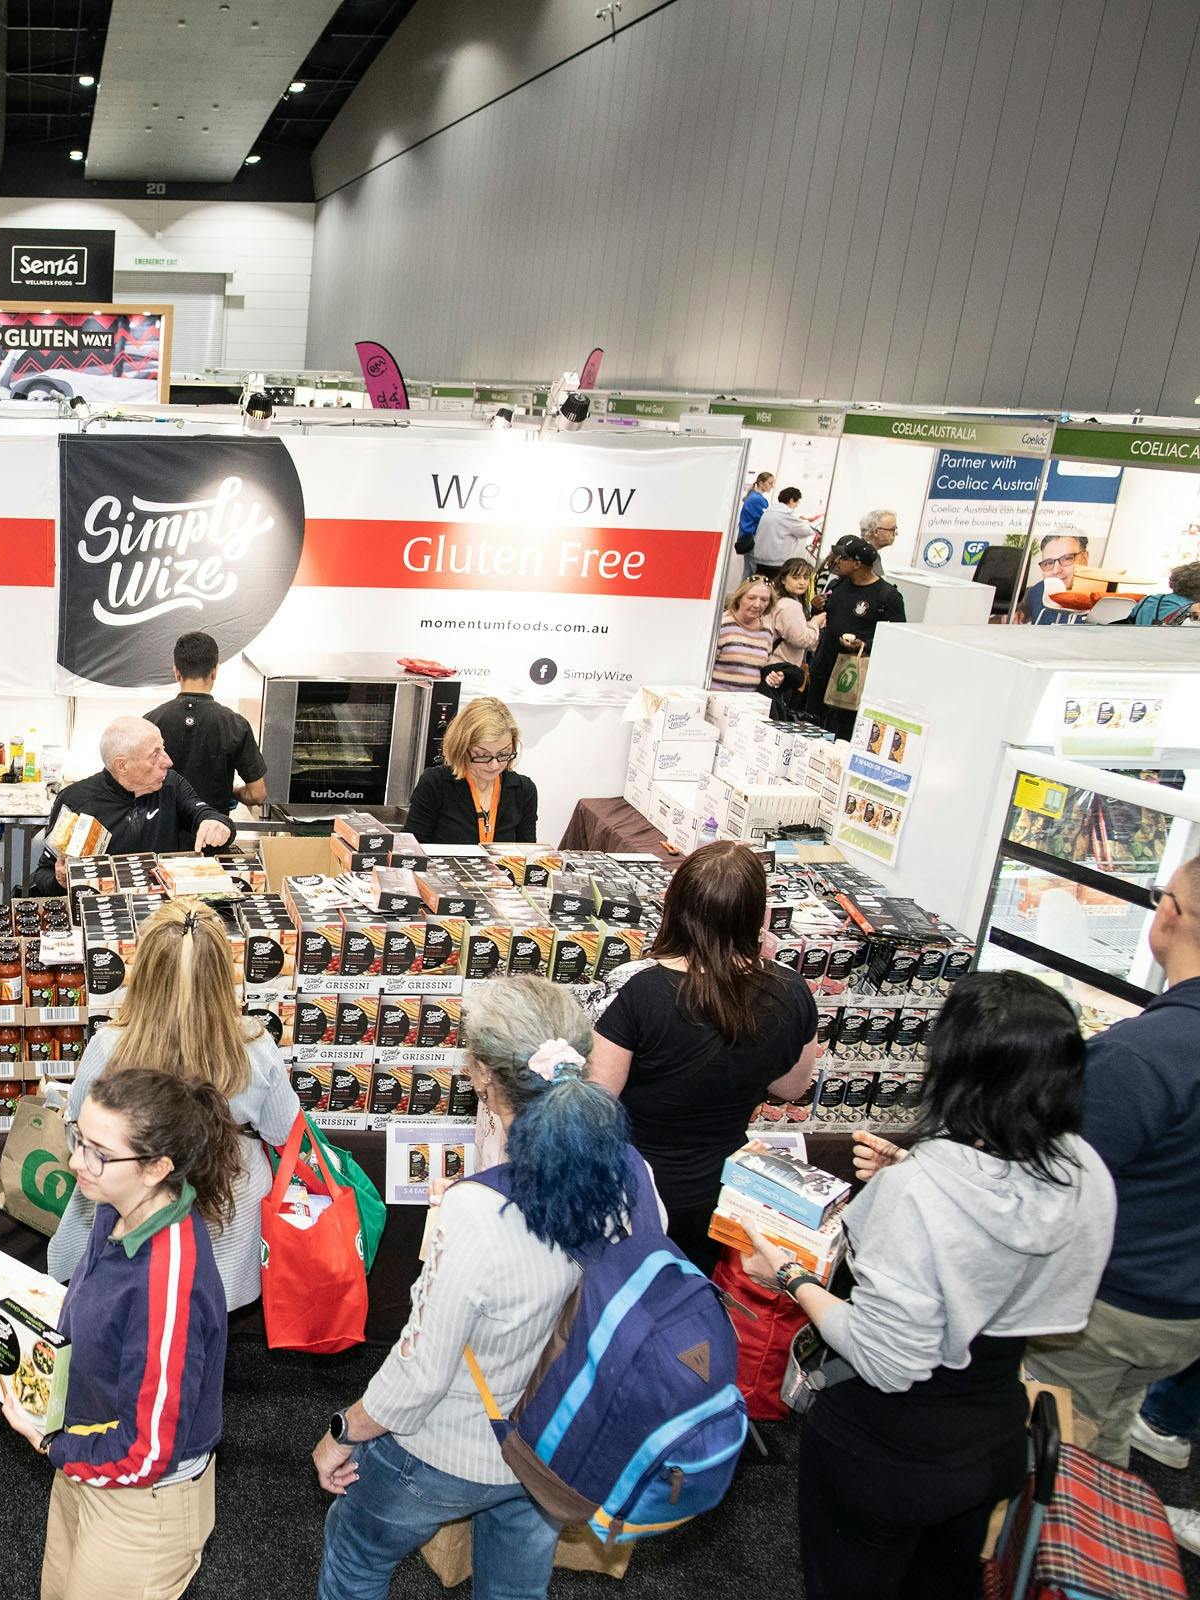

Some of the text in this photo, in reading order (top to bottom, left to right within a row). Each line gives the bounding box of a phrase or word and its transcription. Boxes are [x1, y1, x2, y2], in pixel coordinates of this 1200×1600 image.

[146, 183, 166, 195] 20
[19, 254, 78, 276] Senzá
[134, 258, 178, 266] EMERGENCY EXIT
[3, 327, 79, 350] GLUTEN
[81, 331, 113, 347] WAY!
[756, 412, 772, 423] WEHI
[891, 422, 977, 441] COELIAC AUSTRALIA
[1130, 440, 1190, 458] COELIAC
[941, 454, 1017, 469] Partner with
[936, 475, 989, 490] Coeliac
[930, 504, 961, 514] Coeliac
[963, 504, 998, 514] Australia
[77, 475, 275, 564] Simply
[928, 517, 953, 528] gluten
[954, 516, 970, 526] free
[967, 543, 984, 553] GF
[402, 534, 646, 581] Gluten Free
[419, 615, 610, 635] momentumfoods.com.au
[563, 667, 633, 684] SimplyWize
[310, 789, 364, 800] turbofan
[325, 981, 370, 990] GRISSINI
[407, 981, 452, 990] GRISSINI
[320, 1051, 364, 1059] GRISSINI
[402, 1053, 445, 1061] GRISSINI
[315, 1119, 357, 1127] GRISSINI
